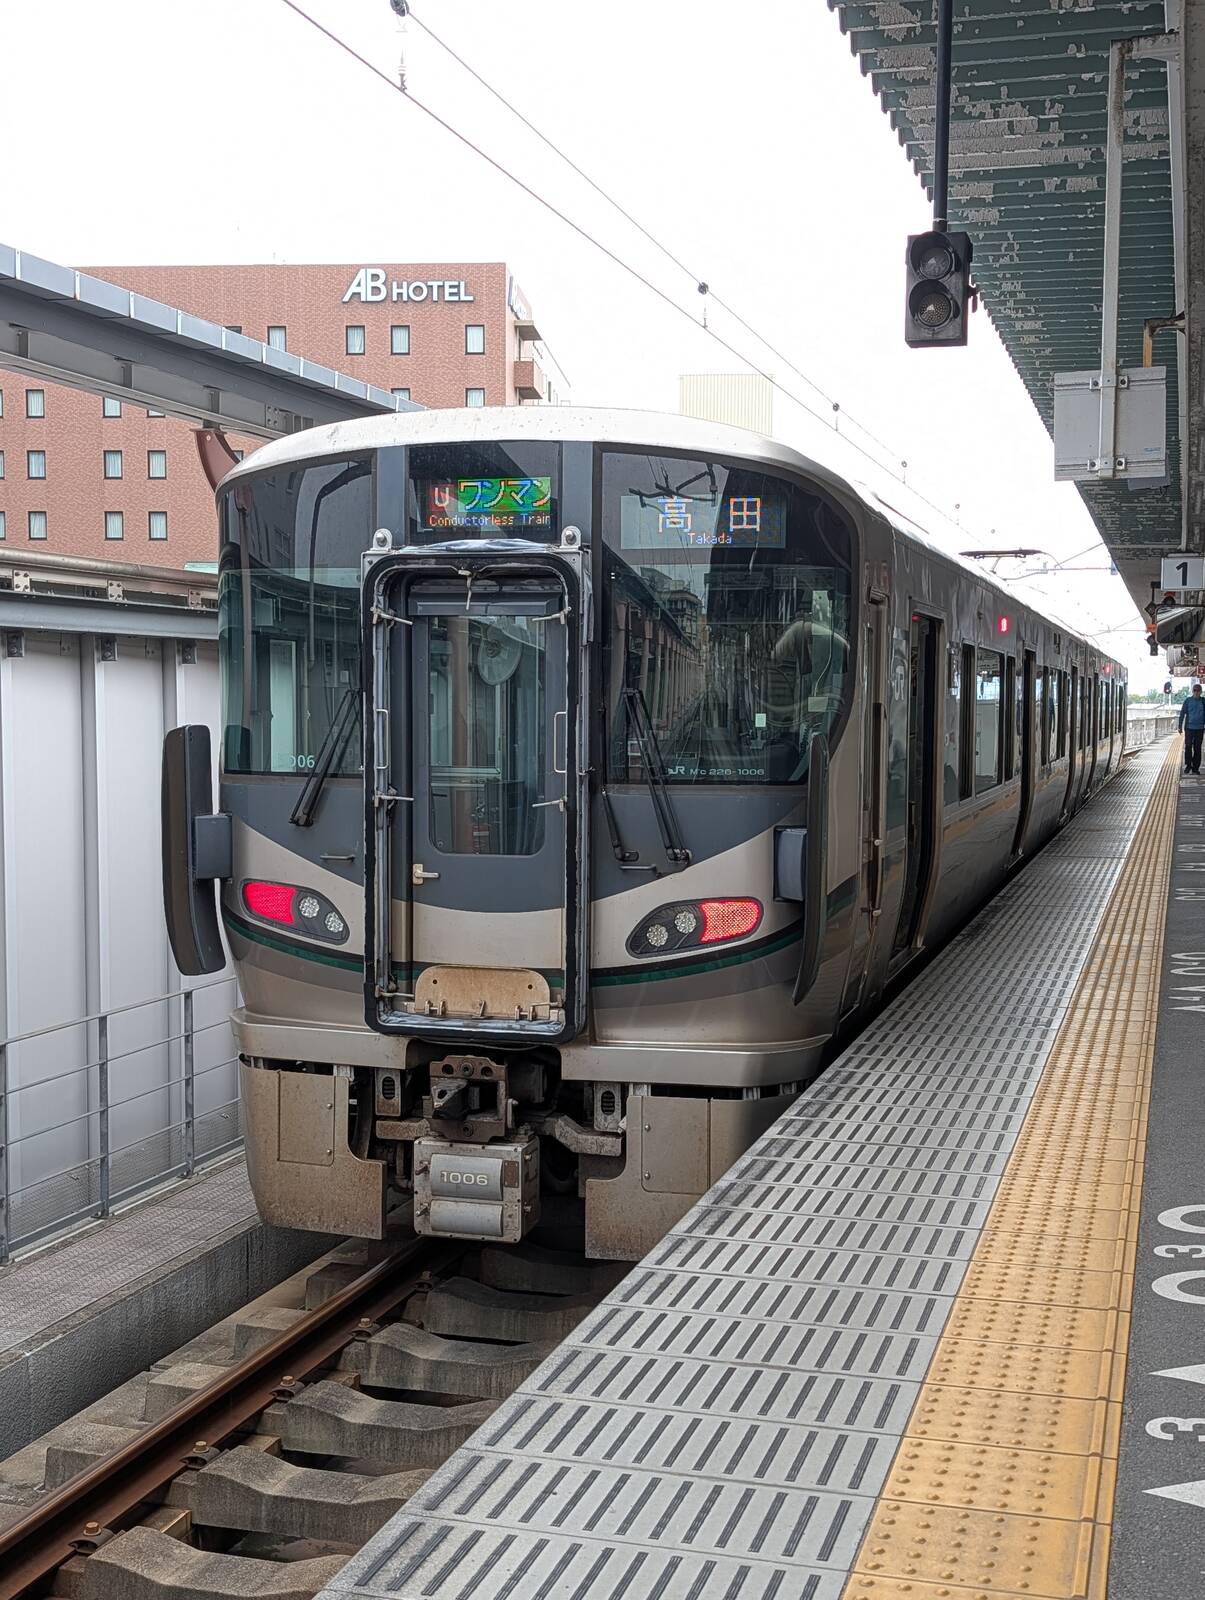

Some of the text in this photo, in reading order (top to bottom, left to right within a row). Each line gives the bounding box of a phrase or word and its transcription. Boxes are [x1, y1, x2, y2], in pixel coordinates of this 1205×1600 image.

[342, 268, 474, 302] AB HOTEL
[460, 479, 551, 511] ワンマン
[429, 513, 514, 527] Conductorless
[657, 495, 761, 533] 高田
[687, 532, 732, 545] Takada
[1175, 561, 1188, 587] 1
[441, 1171, 488, 1186] 1006
